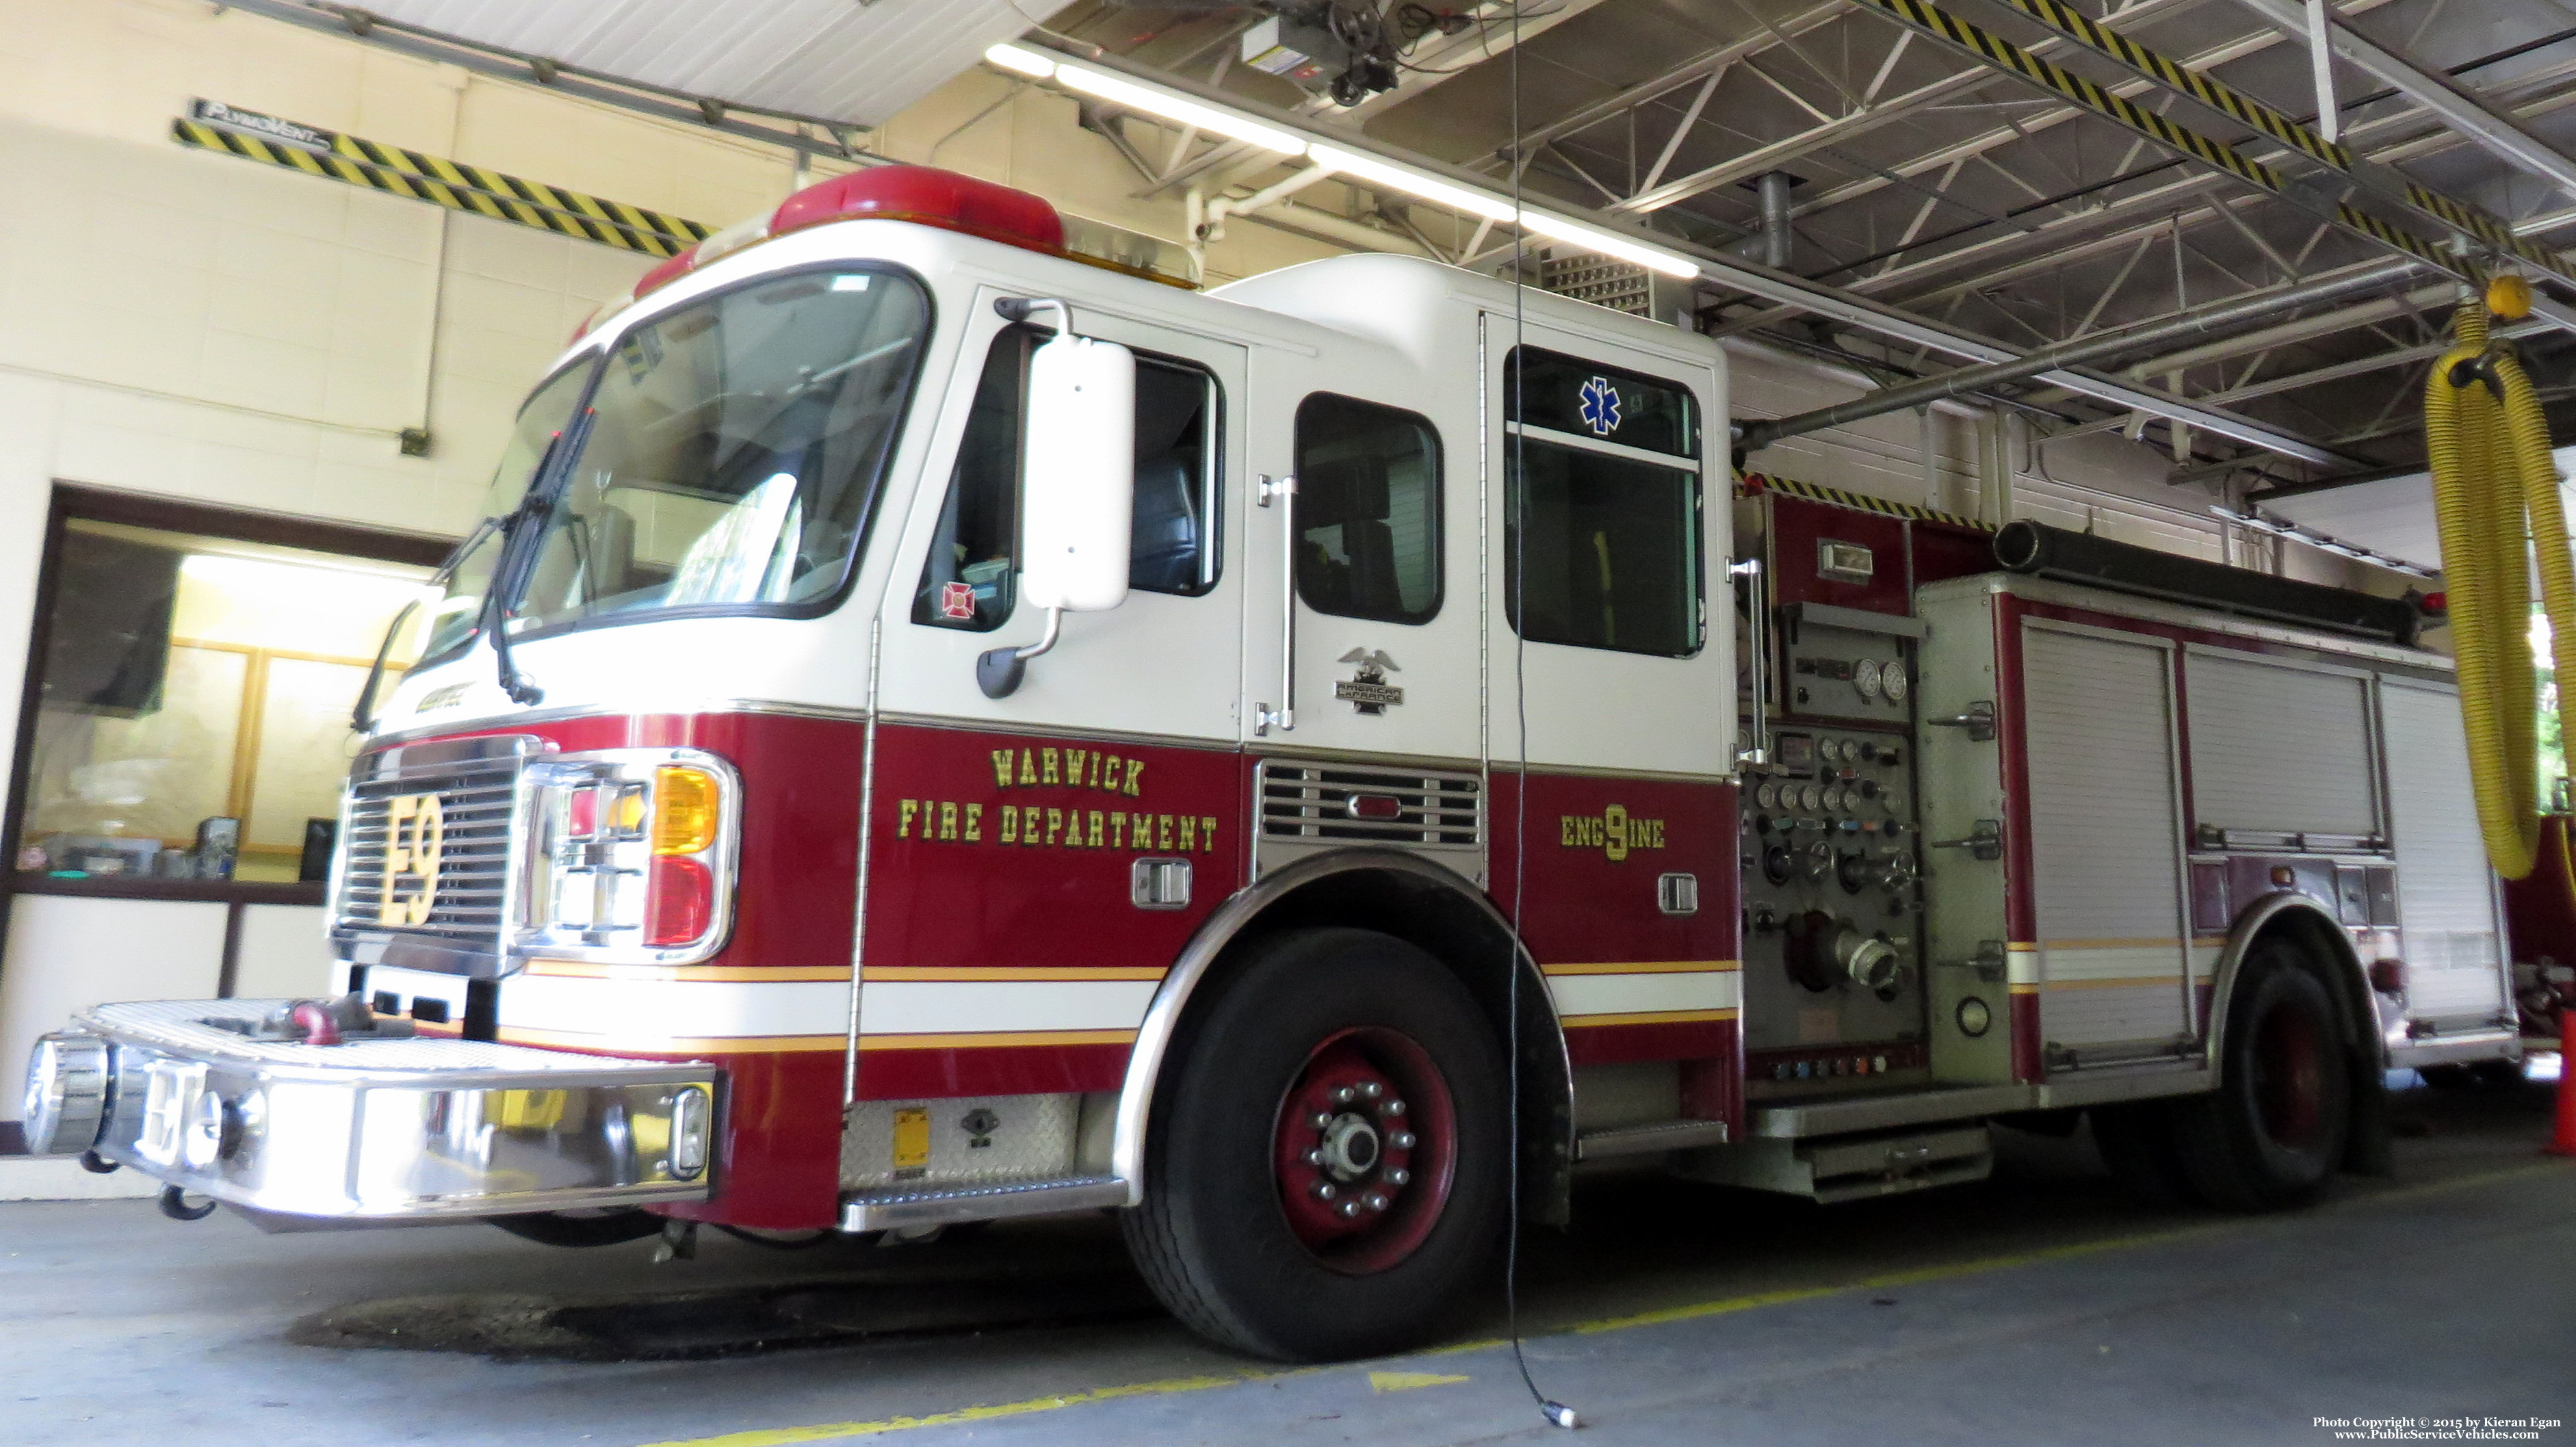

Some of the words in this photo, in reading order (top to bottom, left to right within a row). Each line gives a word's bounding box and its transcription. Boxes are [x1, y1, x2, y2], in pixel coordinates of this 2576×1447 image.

[991, 747, 1145, 797] WARWICK
[898, 799, 983, 843] FIRE
[1000, 805, 1217, 852] DEPARTMENT
[381, 794, 443, 926] E9
